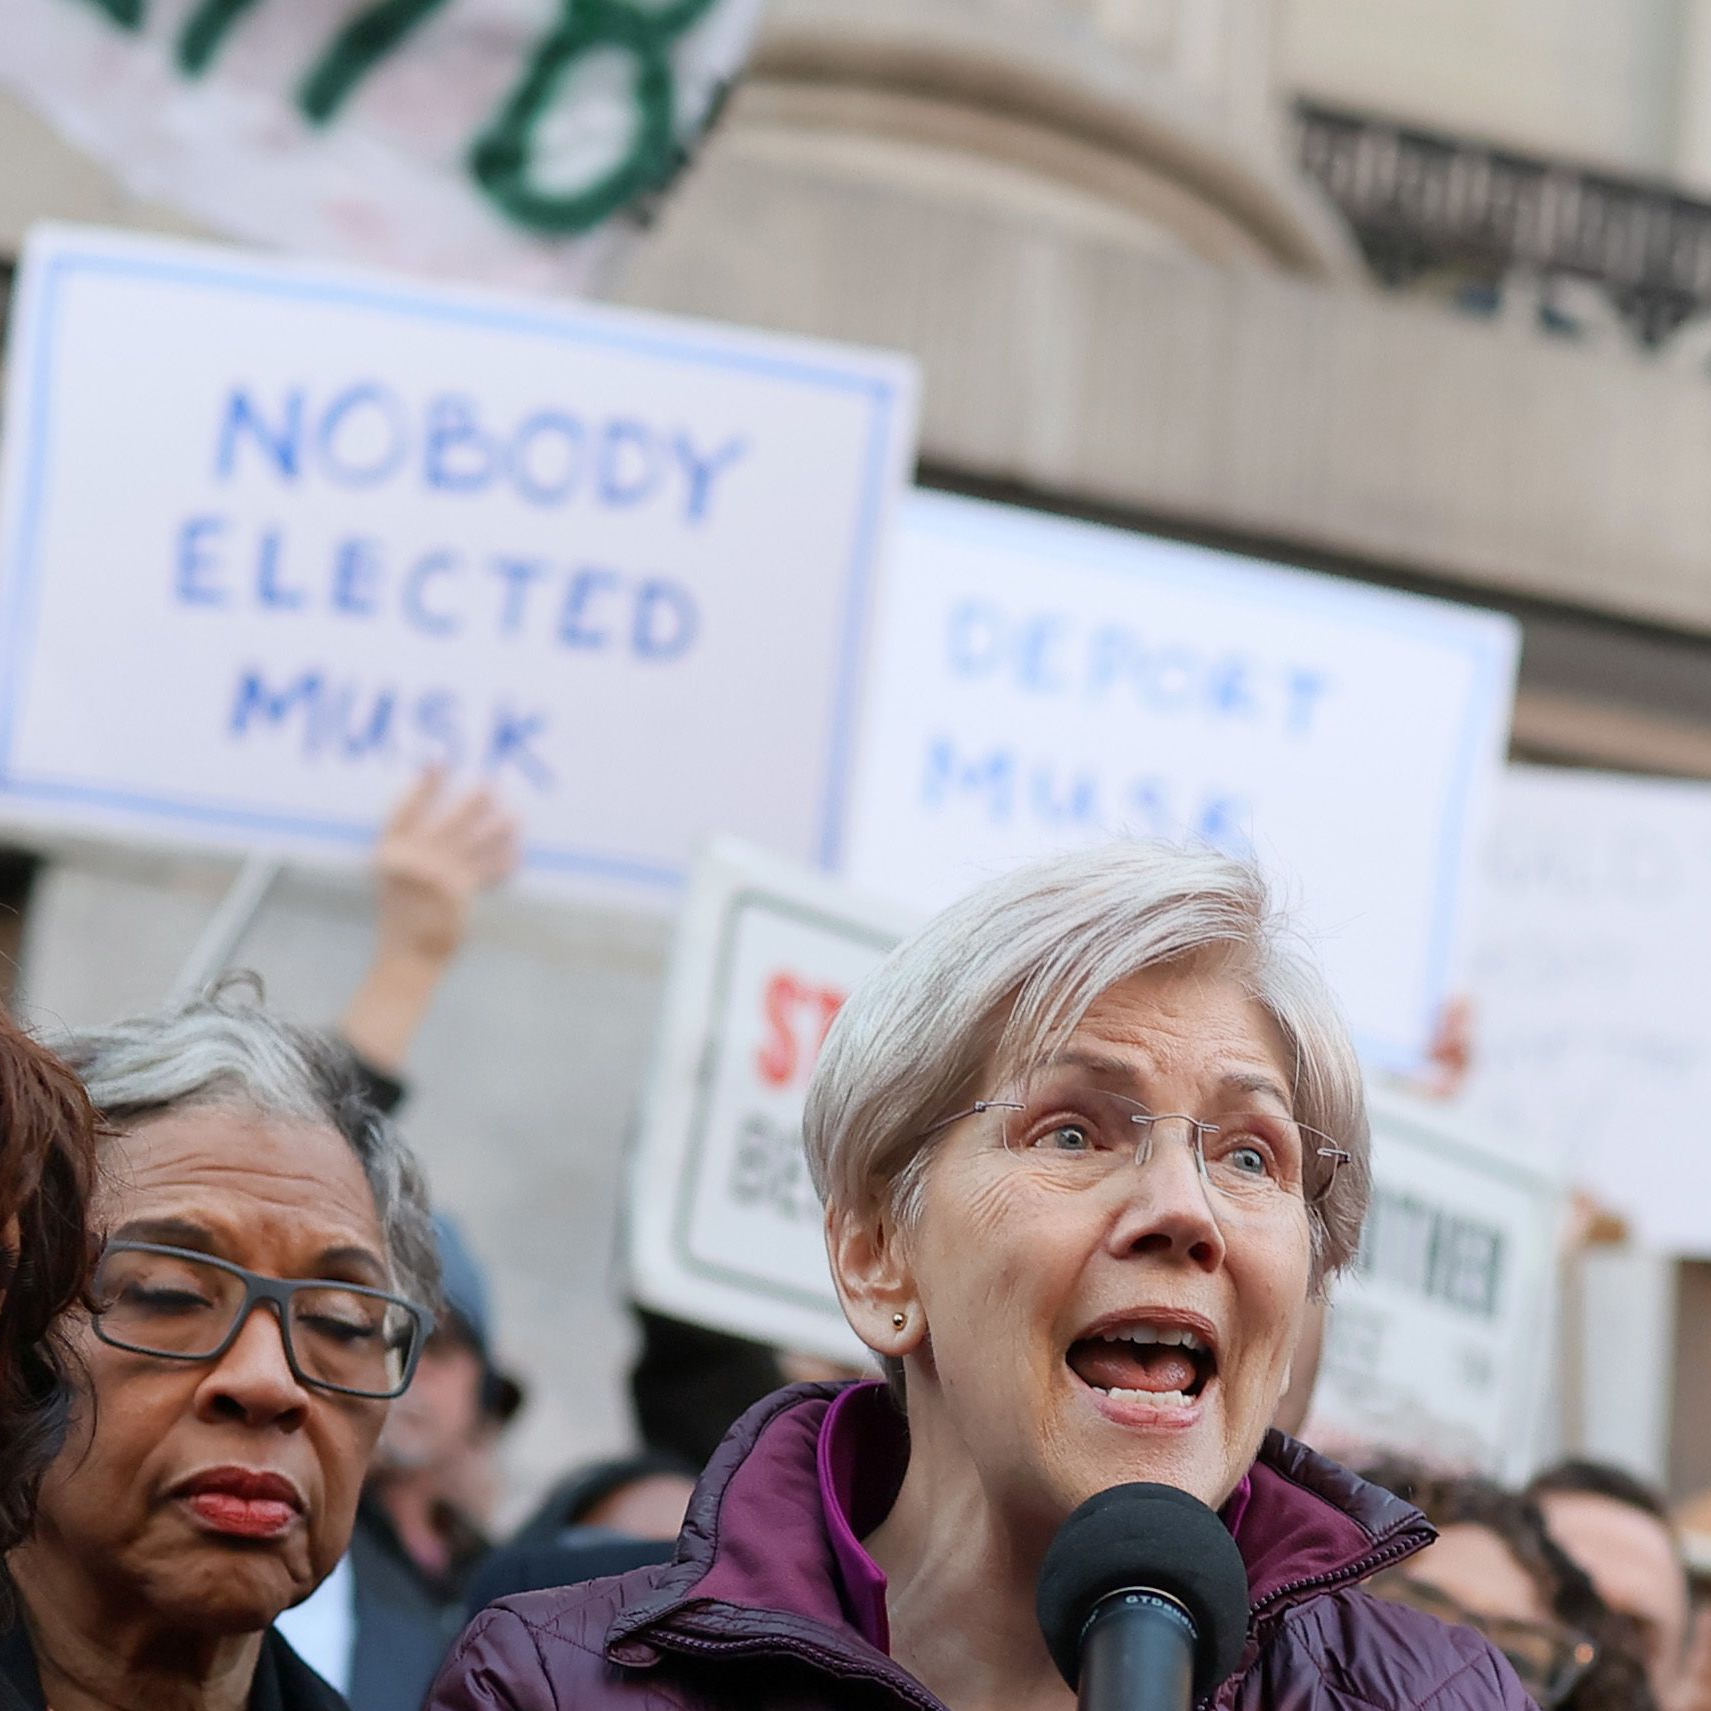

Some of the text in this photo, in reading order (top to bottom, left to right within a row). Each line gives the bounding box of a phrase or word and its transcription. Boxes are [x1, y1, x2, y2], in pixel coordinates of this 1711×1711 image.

[209, 380, 751, 526] NOBODY
[173, 513, 701, 664] ELECTED
[227, 666, 559, 794] MUSK
[944, 594, 1331, 740] DEPORT
